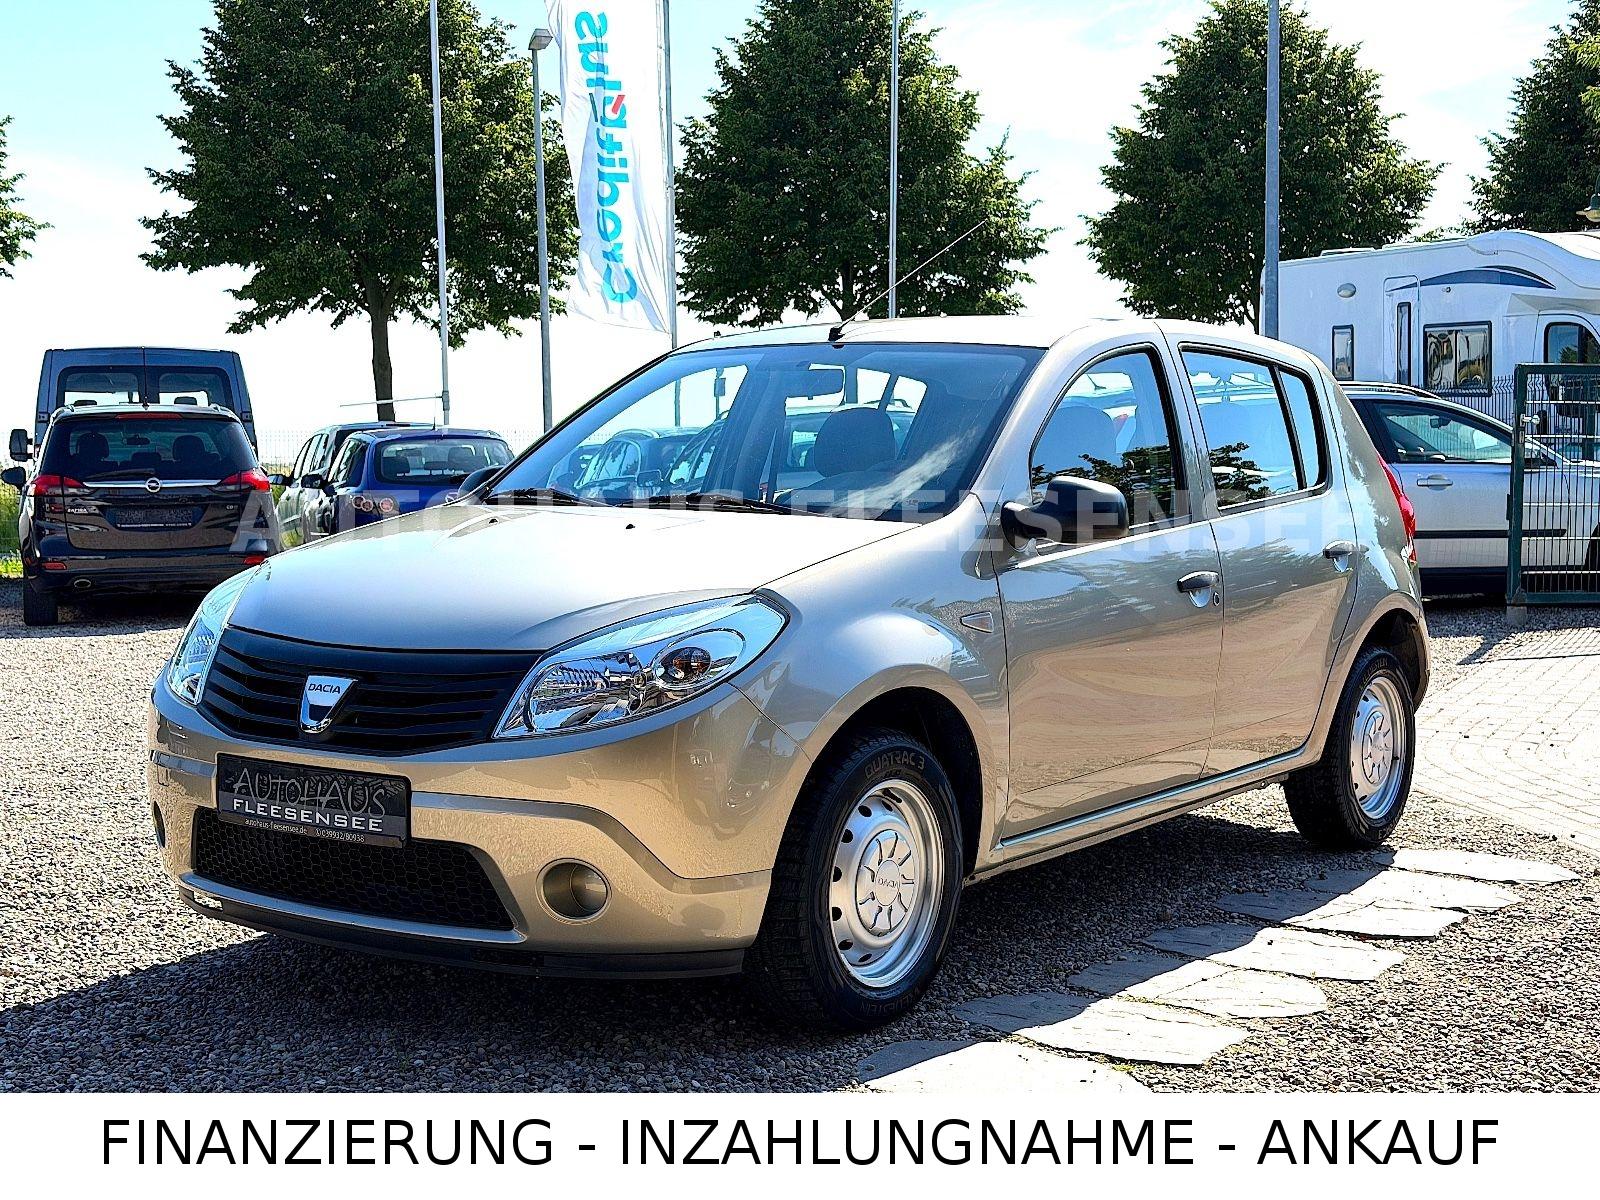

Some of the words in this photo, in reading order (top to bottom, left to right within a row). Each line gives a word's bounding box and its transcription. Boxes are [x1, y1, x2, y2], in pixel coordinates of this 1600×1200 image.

[308, 683, 341, 694] DACIA
[233, 767, 386, 818] AUTOHAUS
[233, 798, 384, 832] FLEESENSEE
